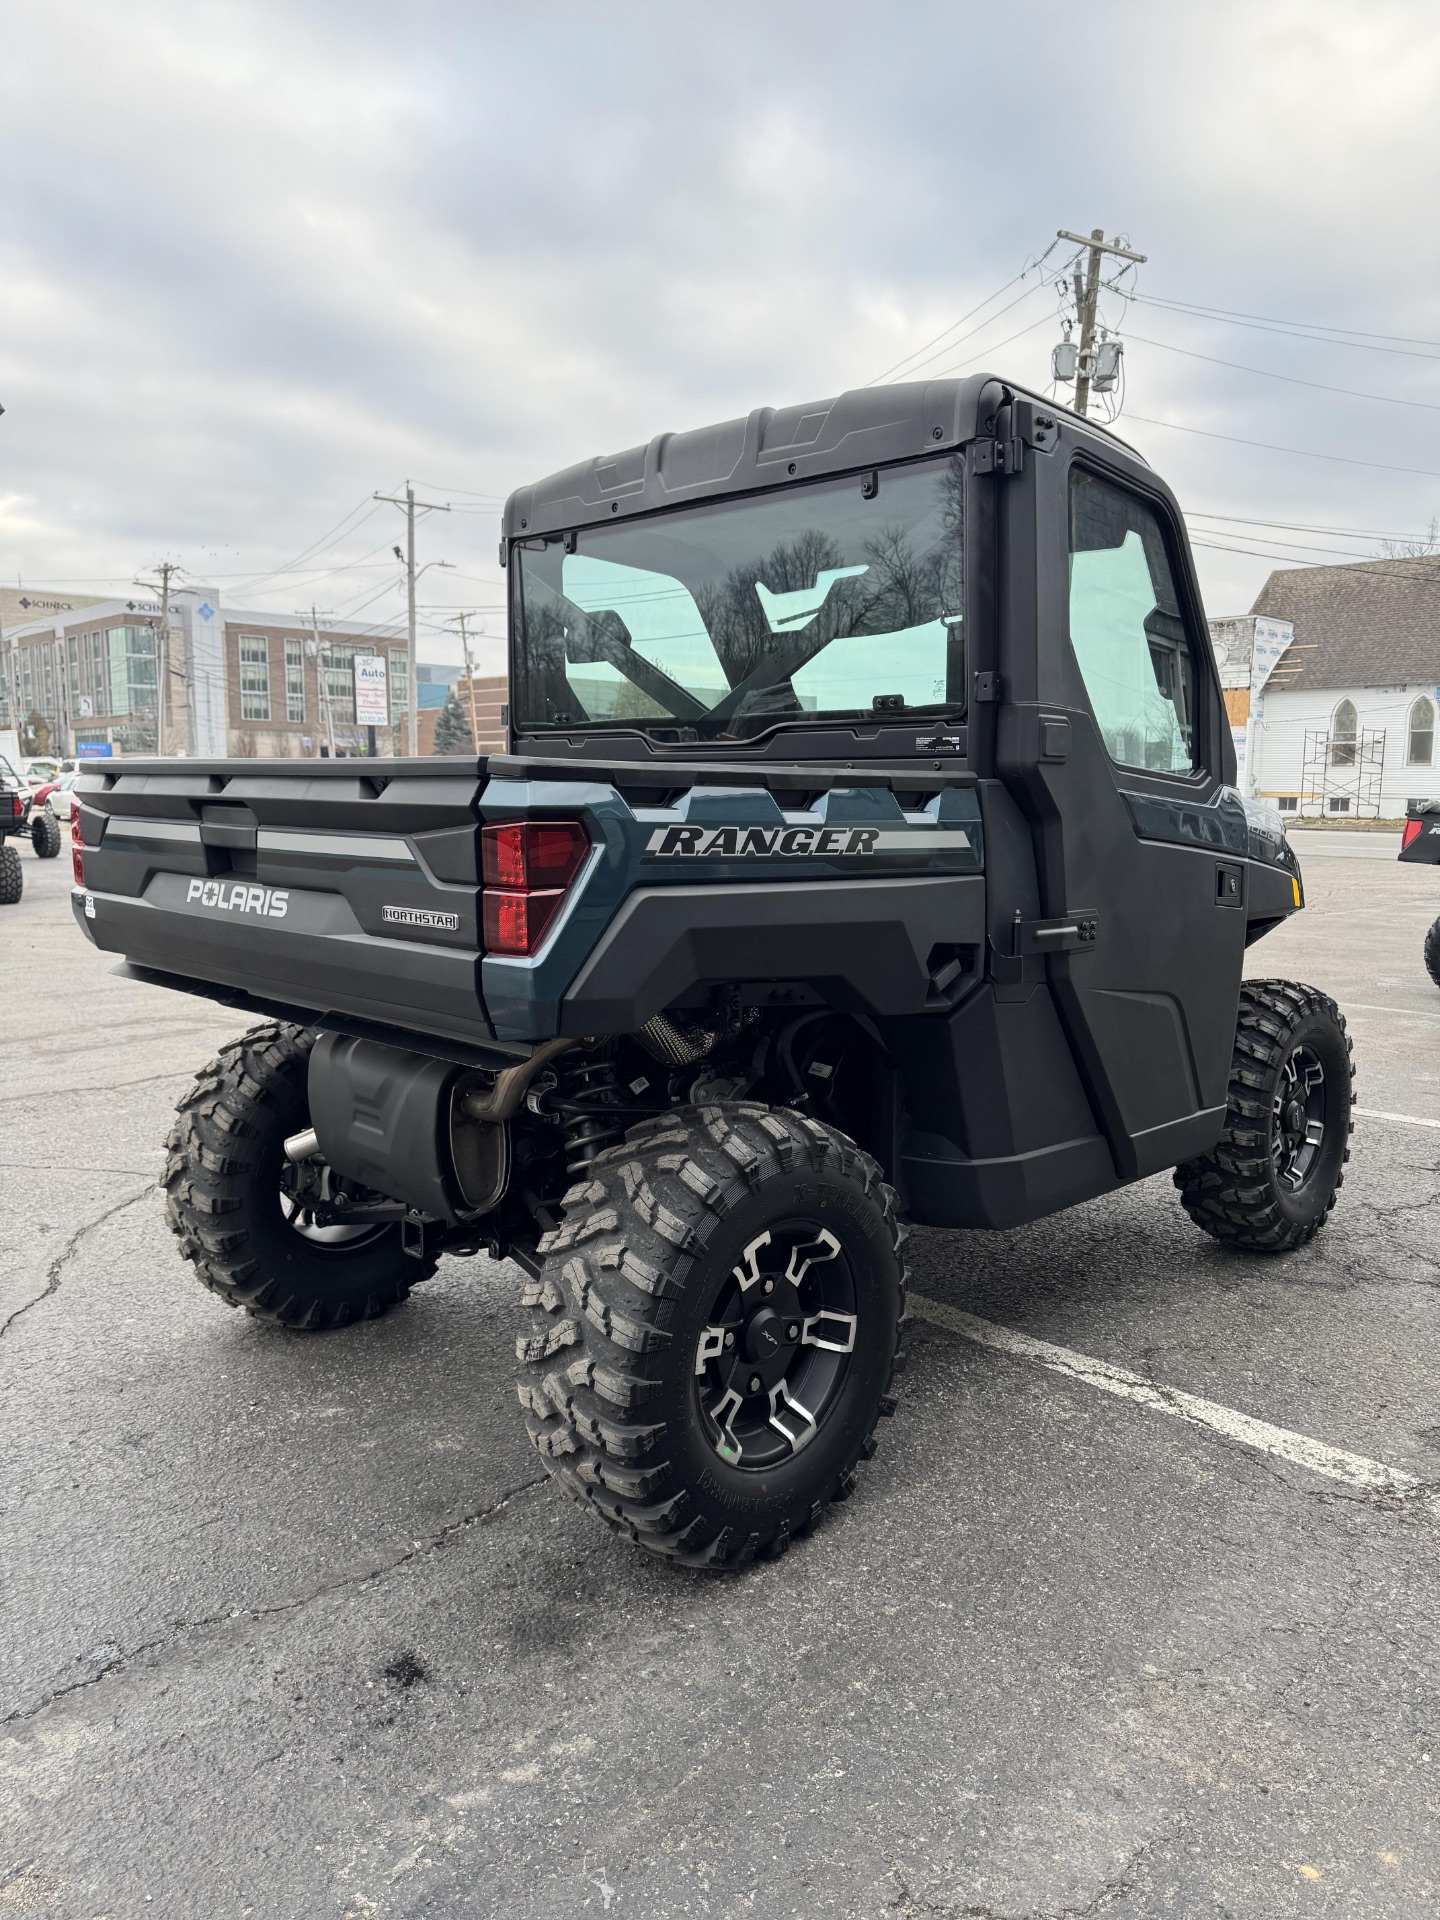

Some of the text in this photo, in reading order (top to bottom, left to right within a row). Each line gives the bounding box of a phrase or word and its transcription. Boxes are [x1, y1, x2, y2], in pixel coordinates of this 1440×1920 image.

[31, 600, 73, 610] SCHNECK
[137, 602, 182, 614] SCHNCK
[361, 668, 385, 678] Auto
[655, 825, 880, 857] RANGER
[186, 879, 290, 918] POLARIS
[385, 909, 453, 927] NORTHSTAR
